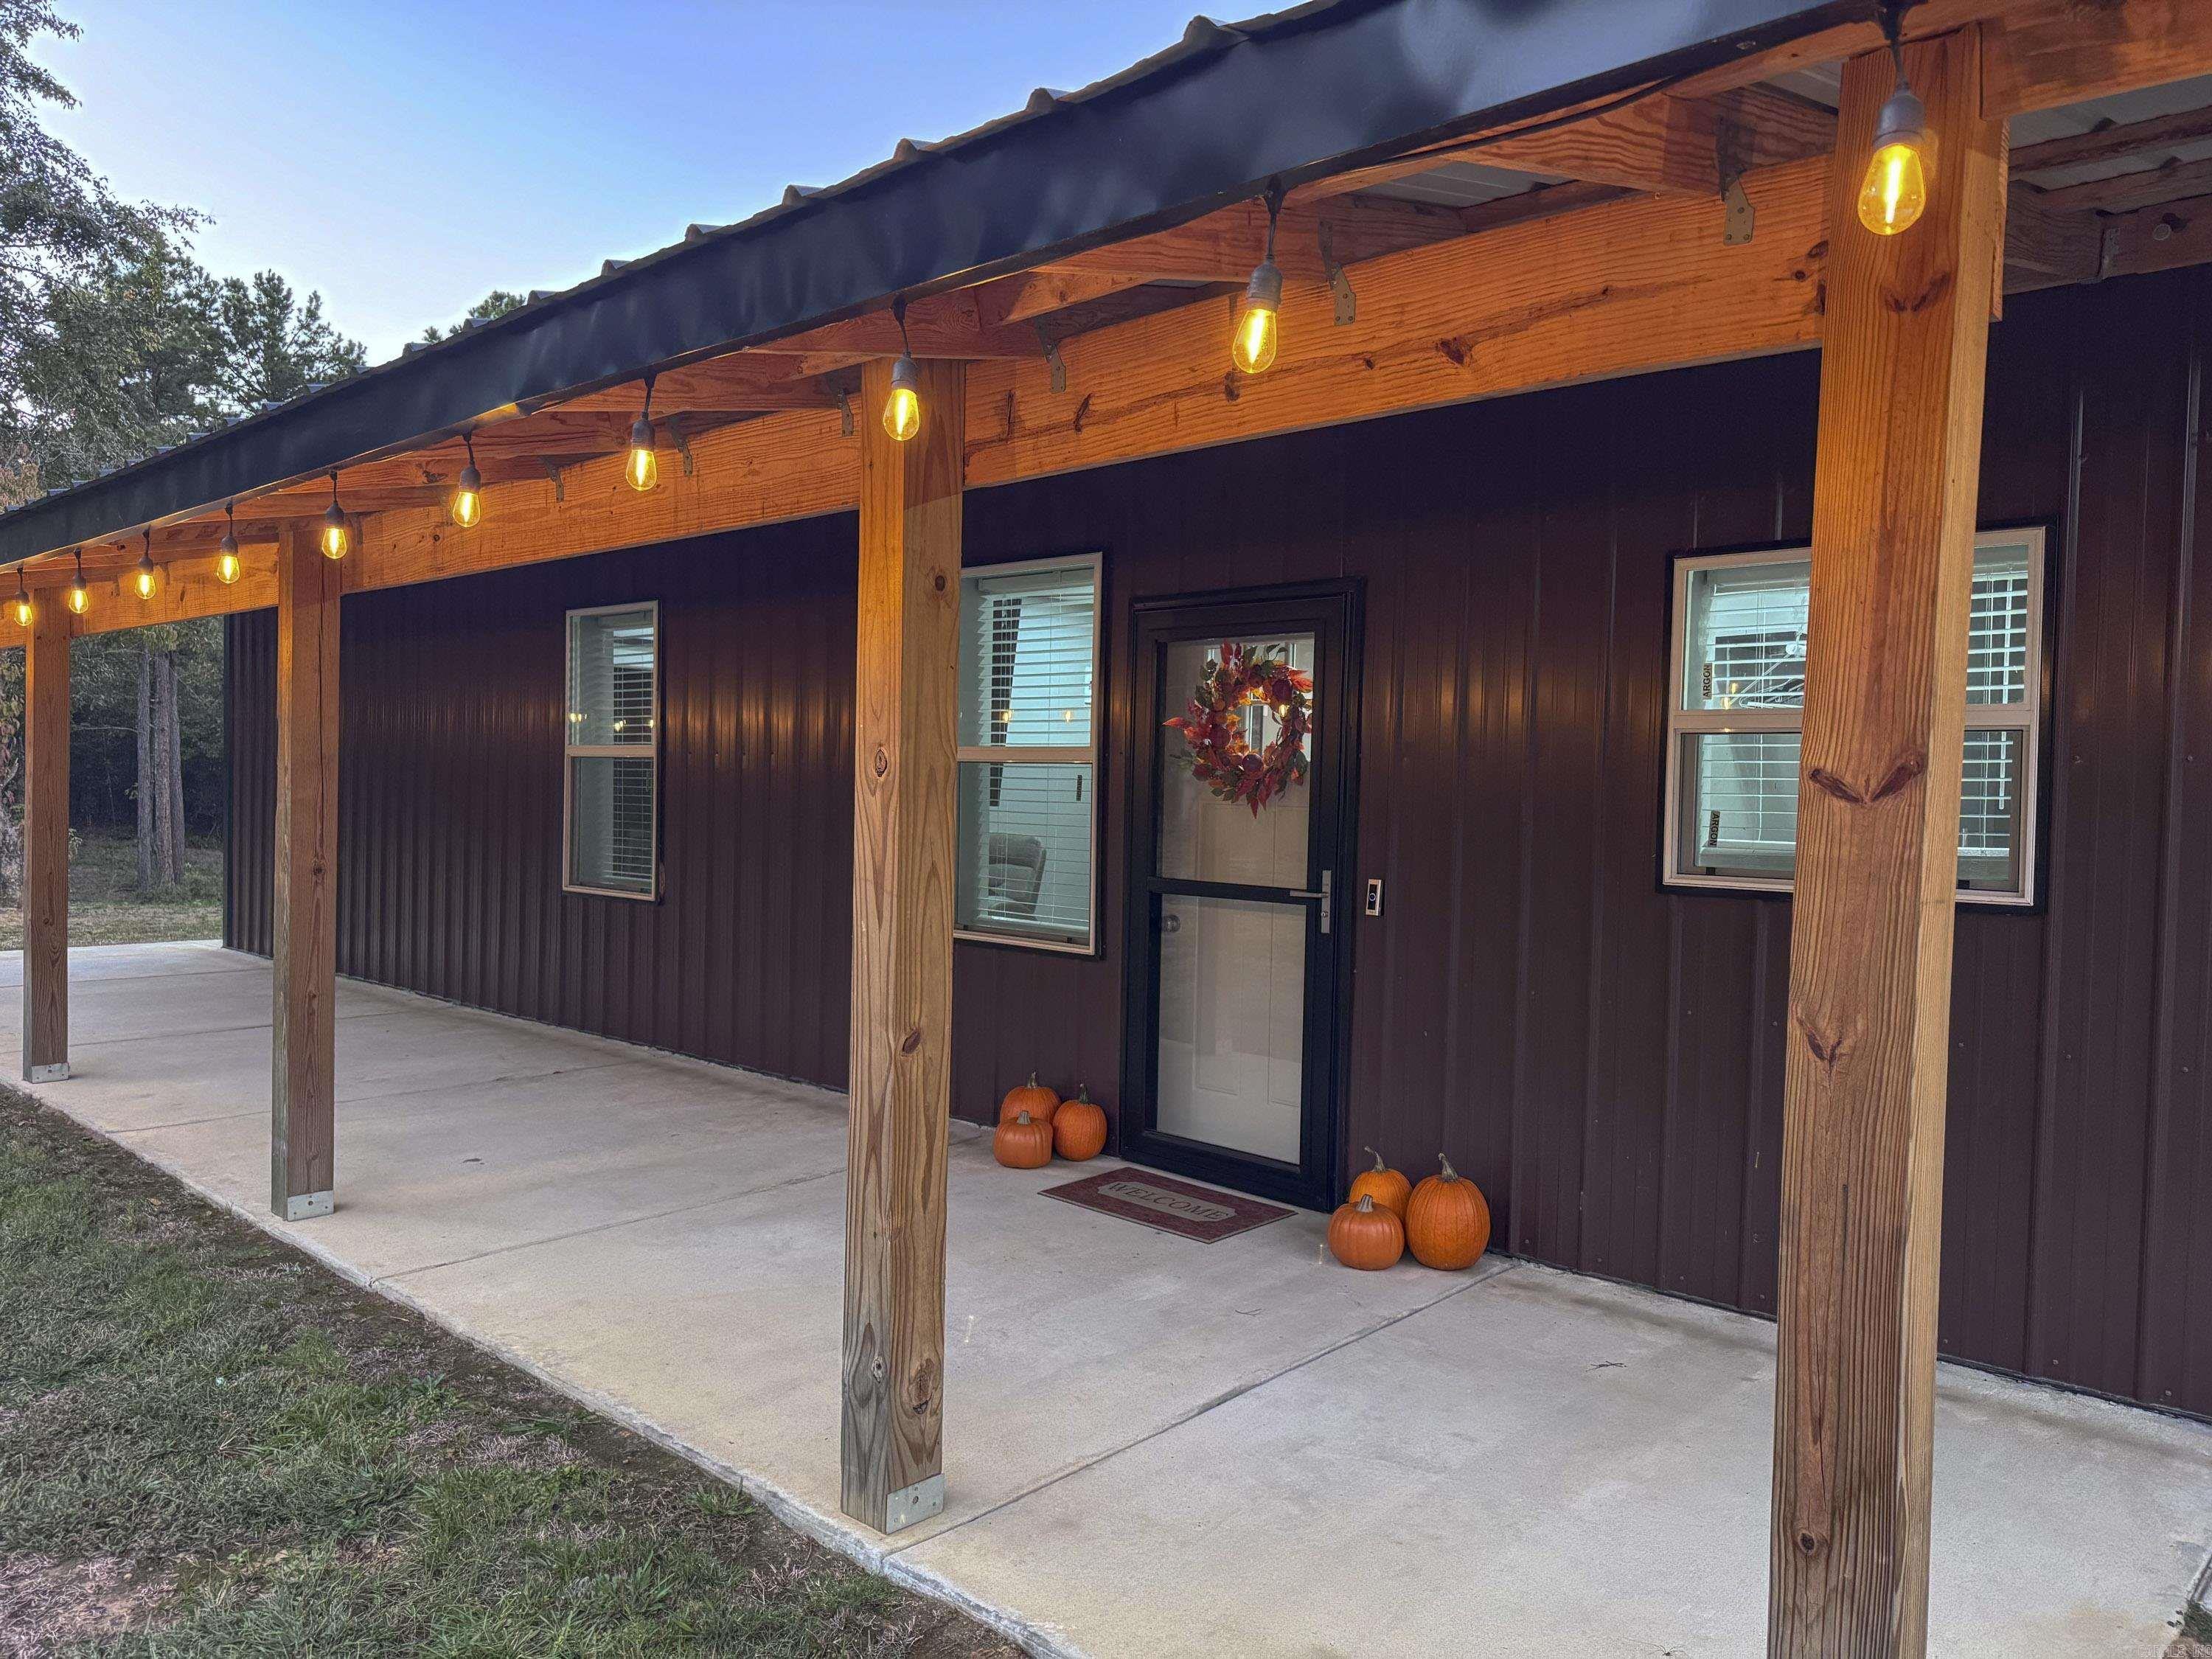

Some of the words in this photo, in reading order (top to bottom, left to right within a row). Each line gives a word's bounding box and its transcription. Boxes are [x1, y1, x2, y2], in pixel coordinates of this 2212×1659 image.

[1703, 664, 1711, 698] ARGON
[1710, 813, 1719, 846] ARGON
[1109, 1183, 1228, 1220] WELCOME
